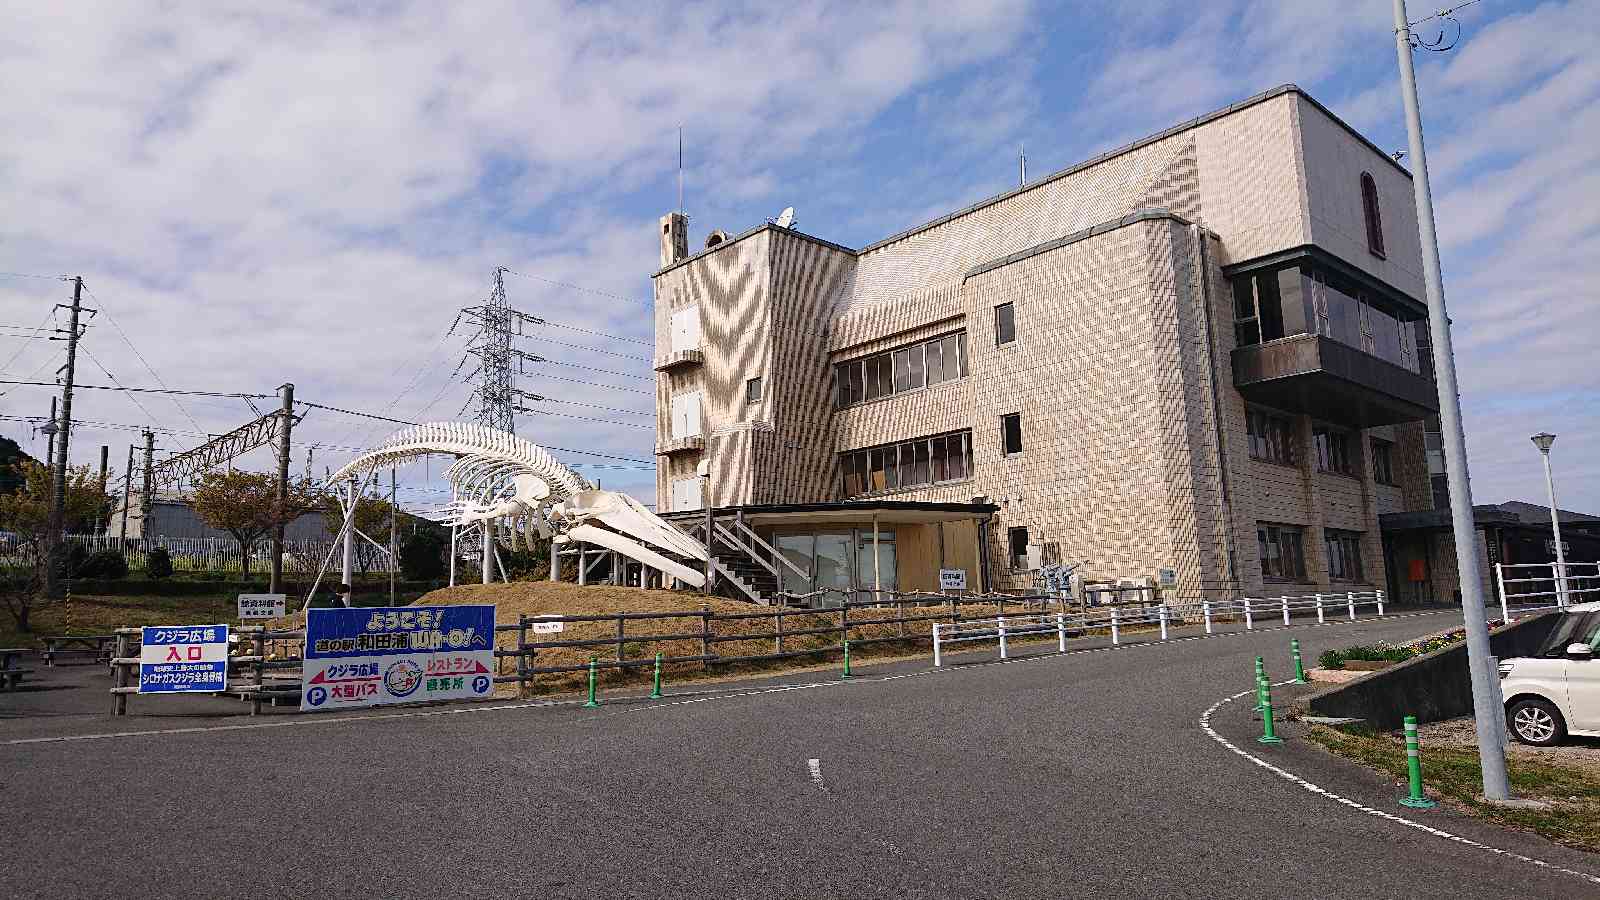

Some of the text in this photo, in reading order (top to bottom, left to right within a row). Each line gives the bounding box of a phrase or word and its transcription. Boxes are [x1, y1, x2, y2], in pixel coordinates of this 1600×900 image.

[154, 628, 216, 643] クジラ広場
[166, 646, 202, 662] 入口
[327, 662, 379, 679] クジラ広場
[426, 656, 473, 672] レストラン
[330, 683, 378, 698] 大型バス
[426, 677, 465, 692] 直売所
